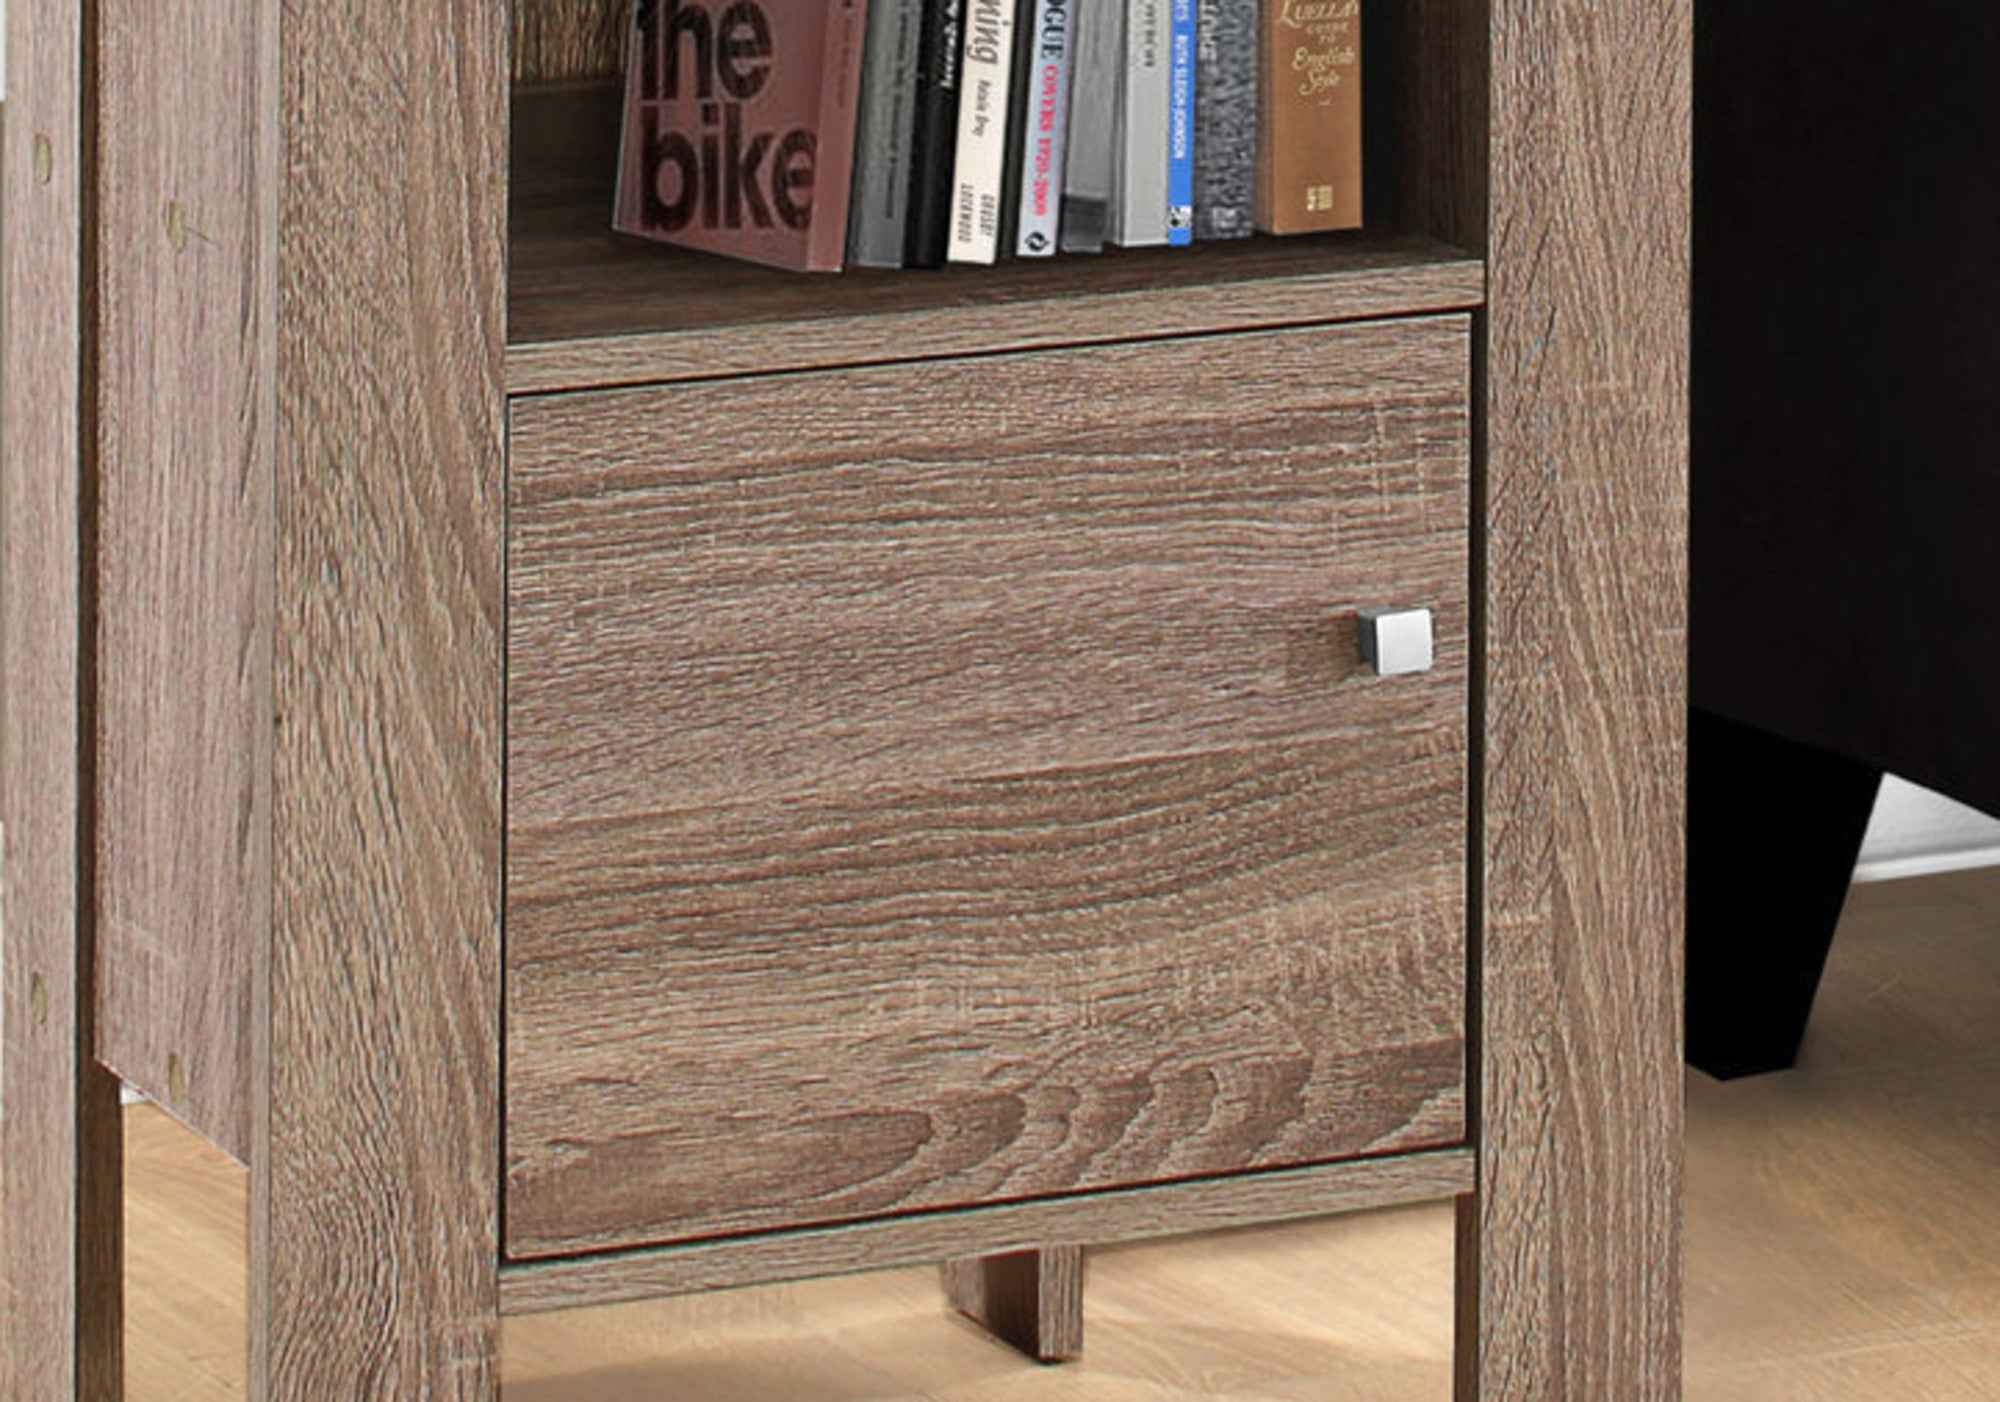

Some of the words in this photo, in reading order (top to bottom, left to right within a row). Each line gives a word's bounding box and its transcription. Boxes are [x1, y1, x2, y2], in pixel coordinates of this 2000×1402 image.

[636, 0, 772, 99] the
[1041, 64, 1057, 131] COVERS
[641, 101, 817, 231] bike
